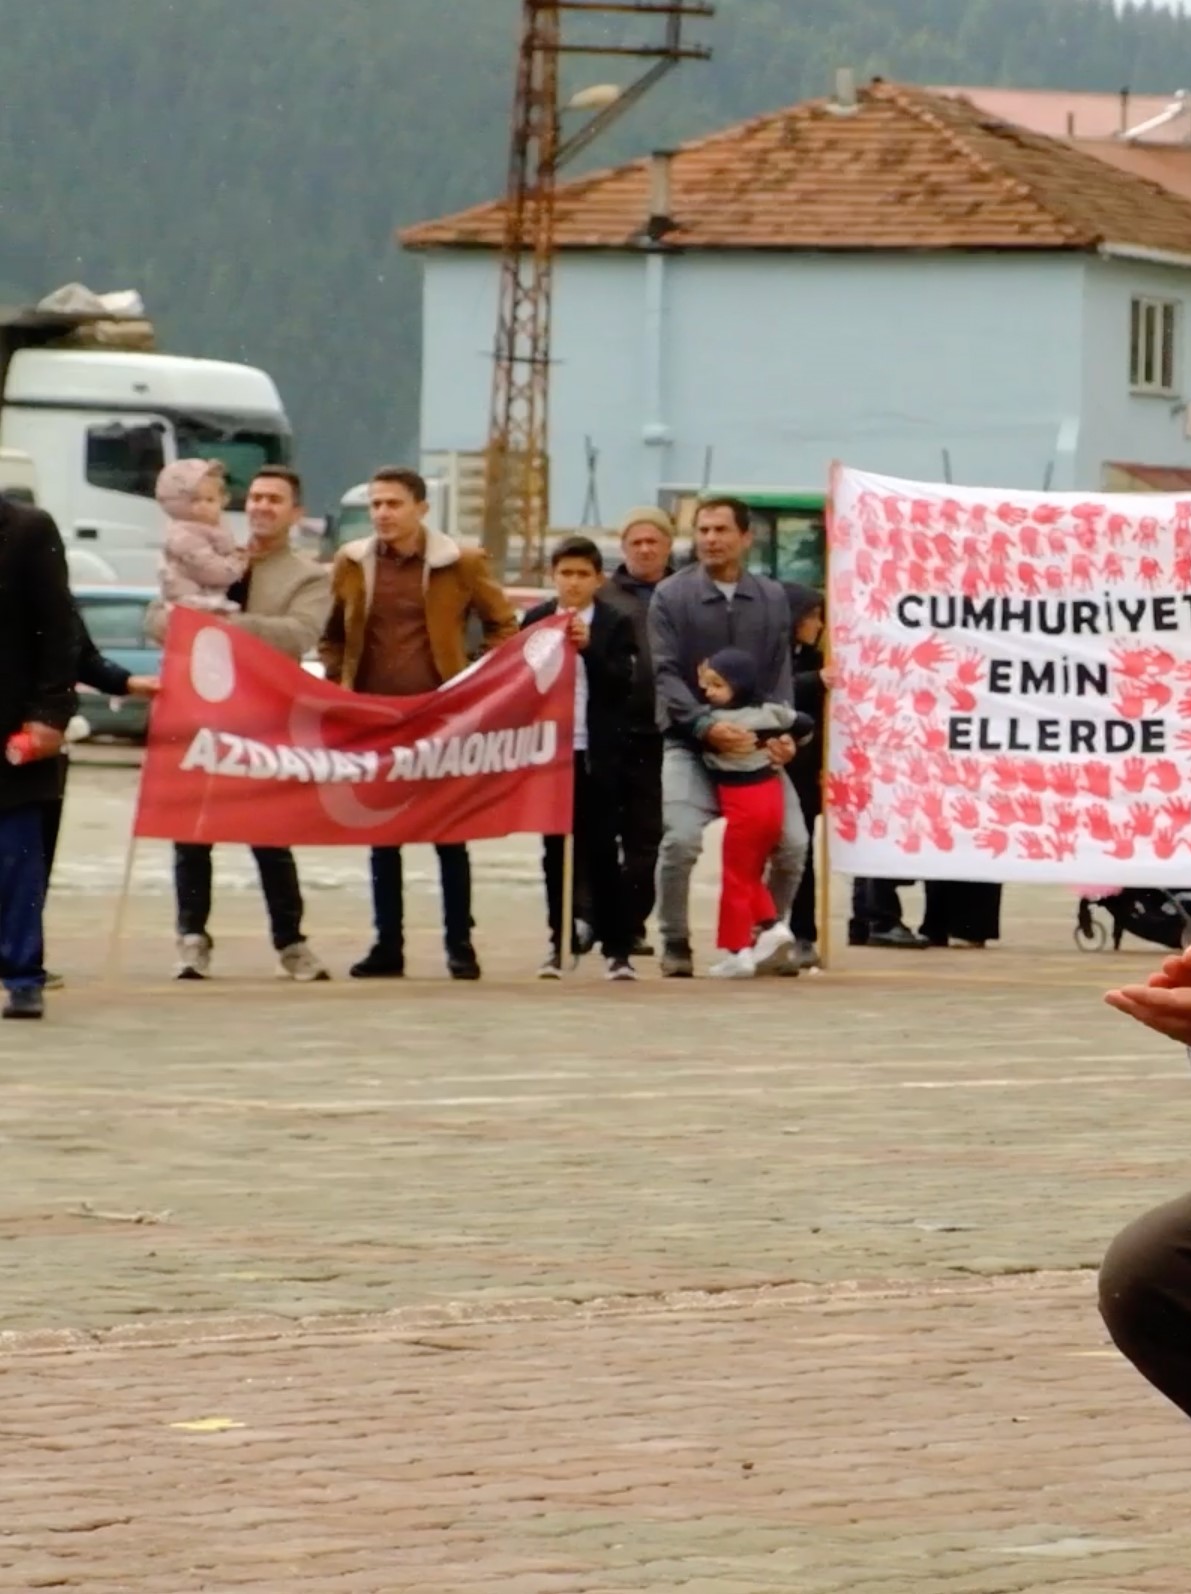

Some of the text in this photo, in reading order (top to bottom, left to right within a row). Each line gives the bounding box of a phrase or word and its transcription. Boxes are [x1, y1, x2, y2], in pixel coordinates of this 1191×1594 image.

[989, 656, 1108, 695] EMİN
[949, 717, 1165, 753] ELLERDE
[179, 727, 379, 783] AZDAVAY
